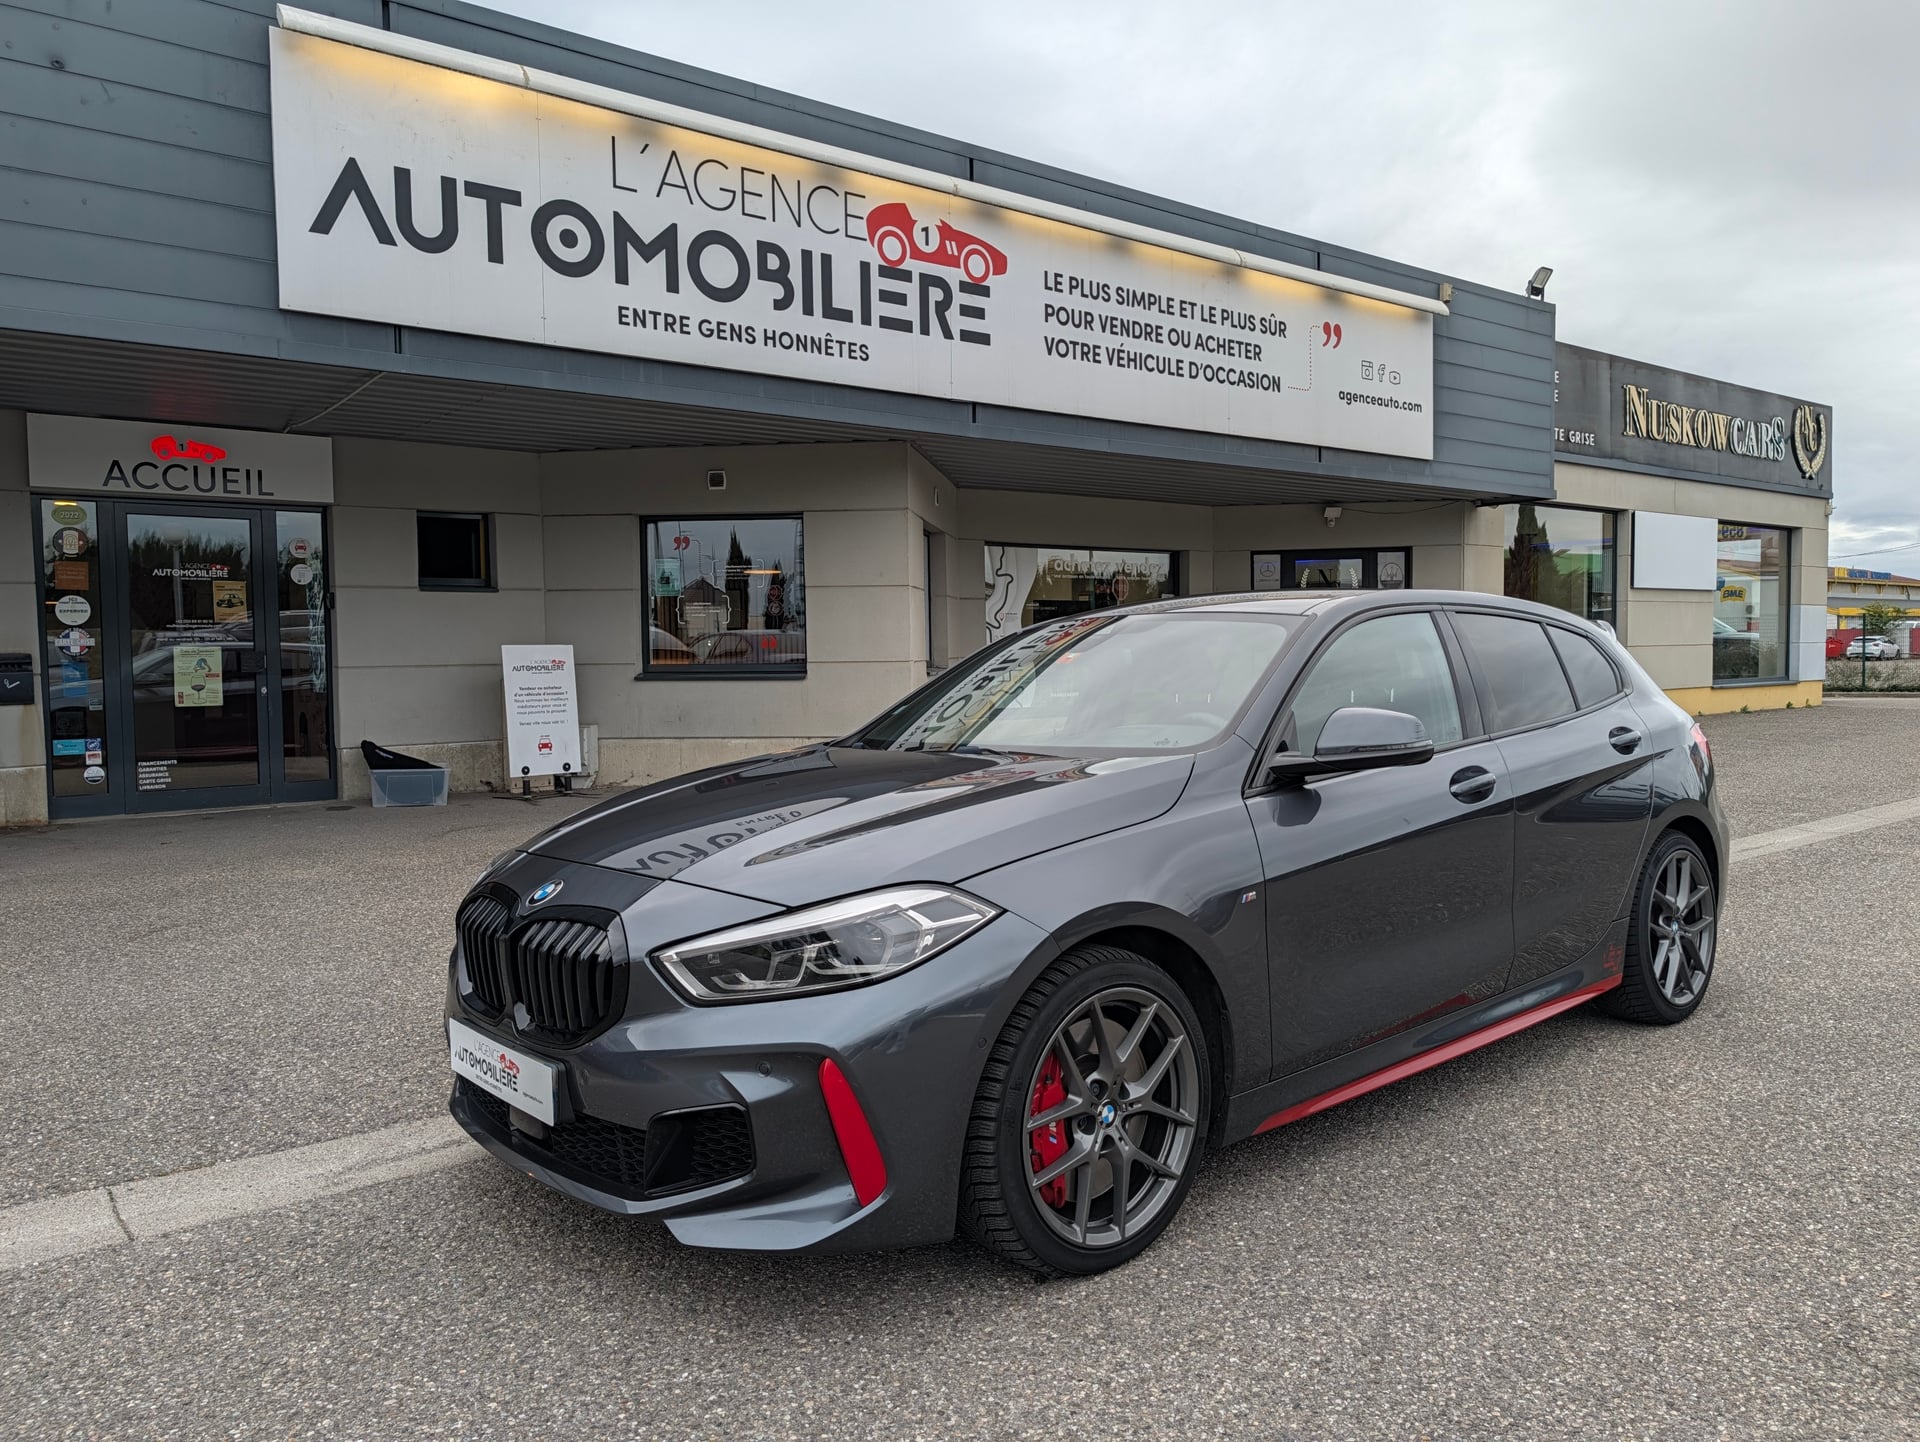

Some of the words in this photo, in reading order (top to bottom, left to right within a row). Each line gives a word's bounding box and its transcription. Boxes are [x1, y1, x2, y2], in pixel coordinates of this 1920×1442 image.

[920, 226, 930, 247] 1
[1044, 270, 1064, 294] LE
[1069, 275, 1111, 303] PLUS
[1115, 286, 1175, 316] SIMPLE
[1179, 299, 1197, 320] ET
[1201, 303, 1217, 325] LE
[1221, 308, 1256, 332] PLUS
[1259, 313, 1287, 339] SÛR
[617, 305, 691, 336] ENTRE
[698, 318, 757, 345] GENS
[763, 328, 870, 362] HONNÊTES
[1044, 303, 1095, 332] POUR
[1098, 313, 1164, 344] VENDRE
[1167, 328, 1191, 349] OU
[1194, 333, 1262, 362] ACHETER
[1044, 335, 1102, 364] VOTRE
[1105, 342, 1185, 378] VÉHICULE
[1188, 360, 1281, 393] D'OCCASION
[1338, 390, 1423, 413] agenceauto.com
[1568, 430, 1596, 446] GRISE
[102, 459, 274, 497] ACCUEIL
